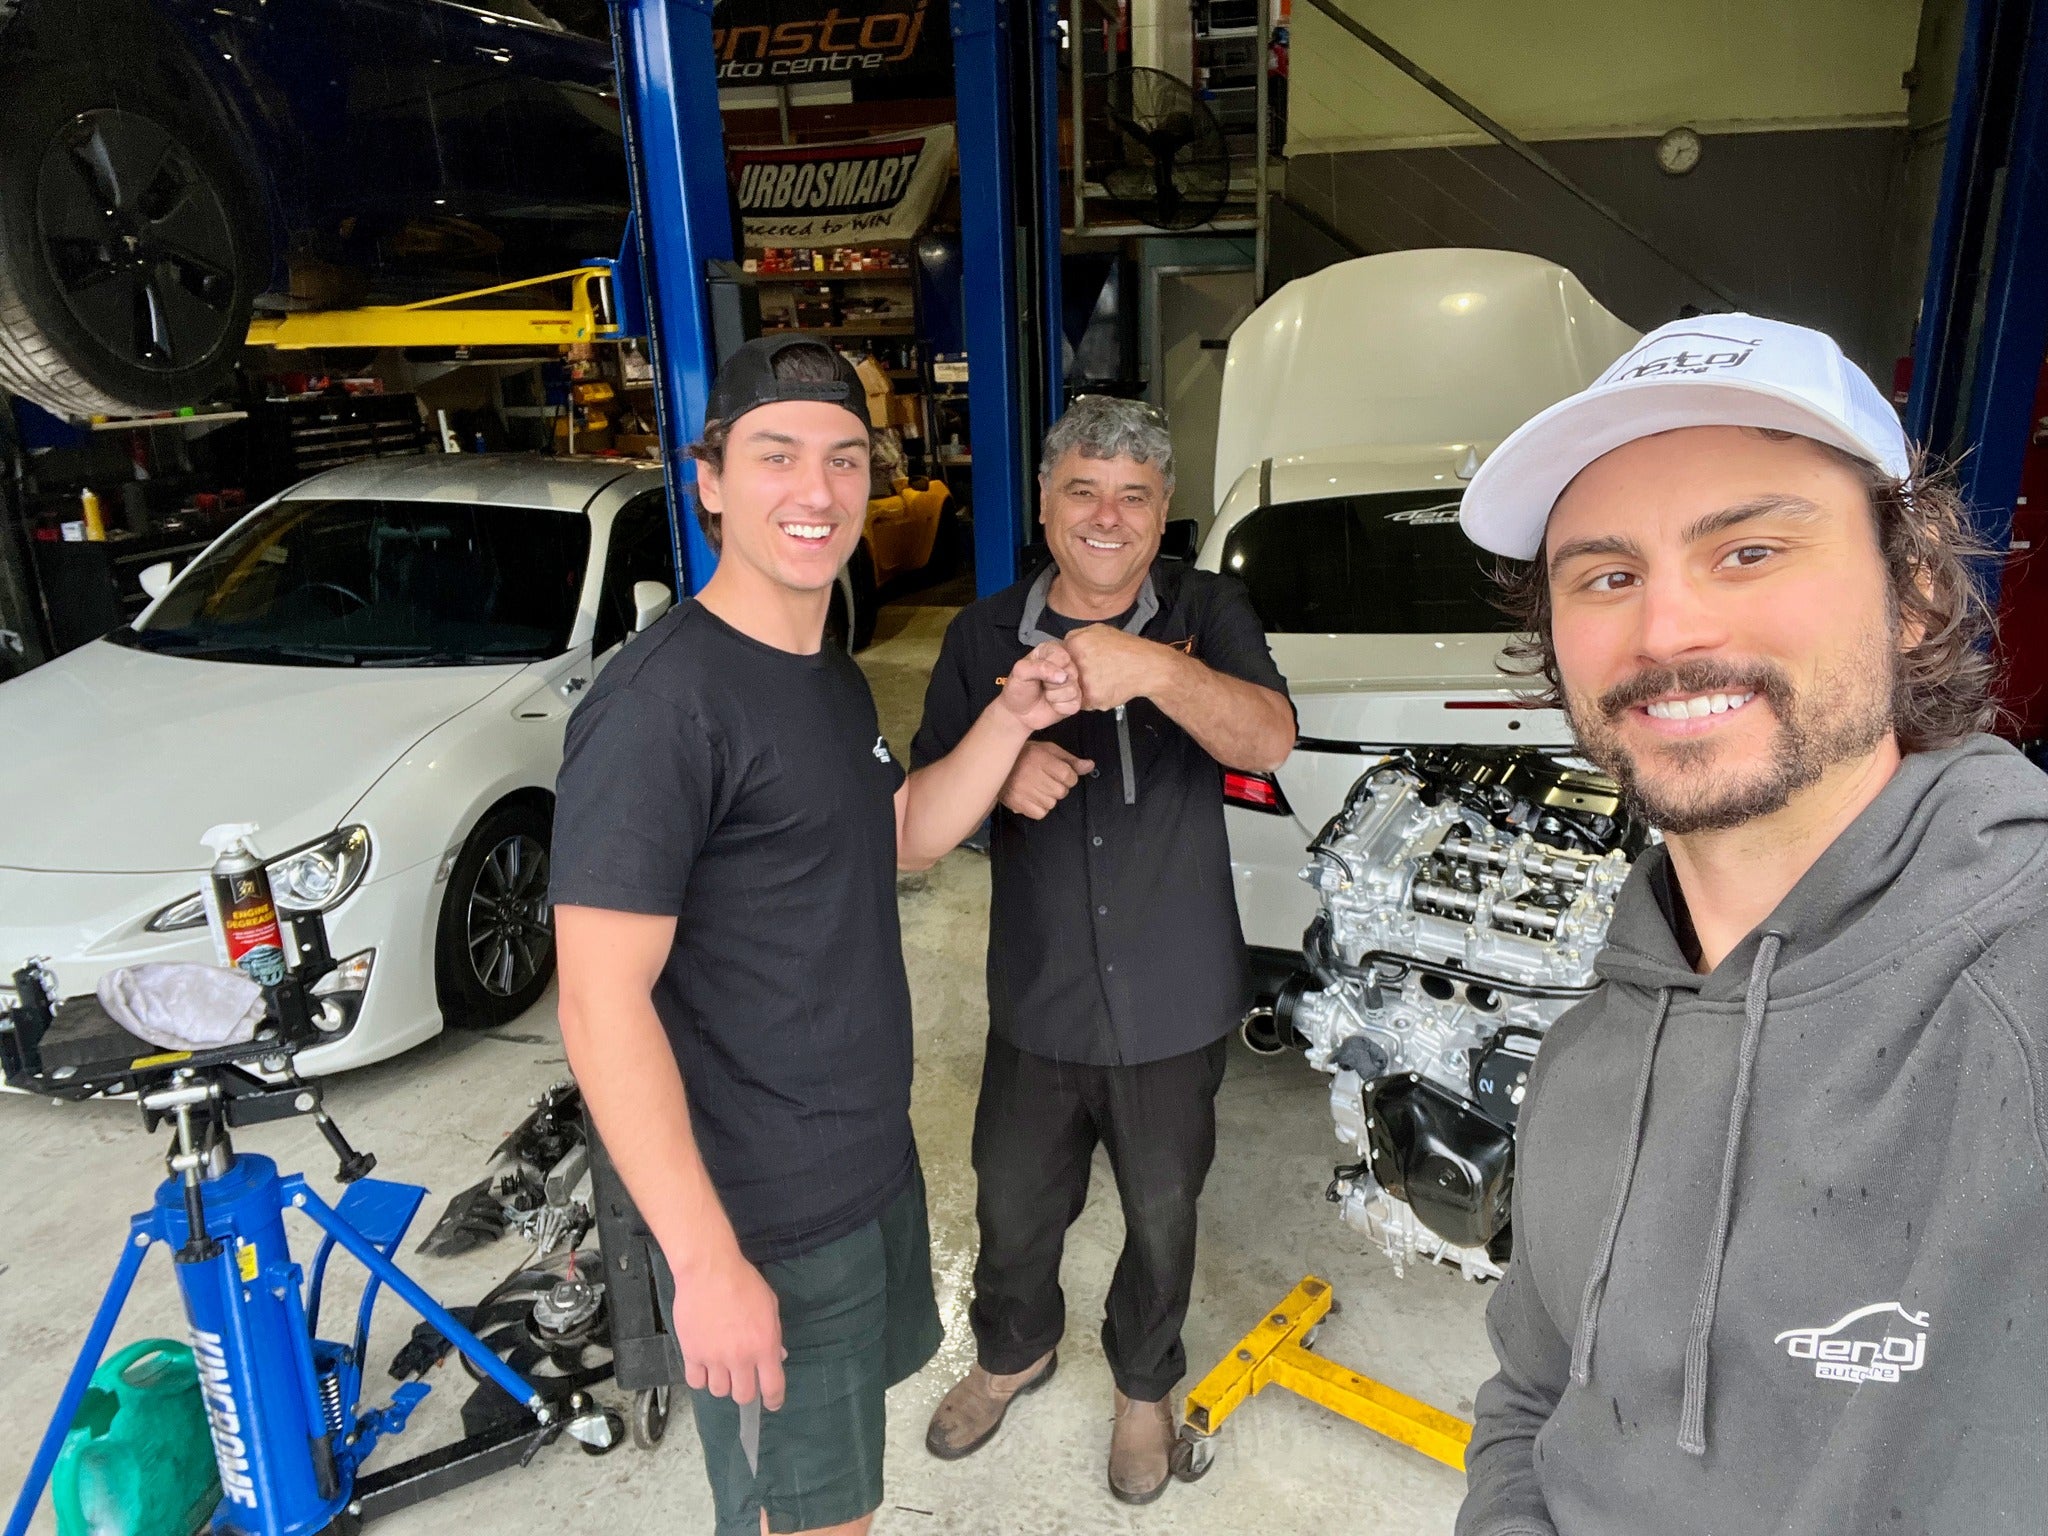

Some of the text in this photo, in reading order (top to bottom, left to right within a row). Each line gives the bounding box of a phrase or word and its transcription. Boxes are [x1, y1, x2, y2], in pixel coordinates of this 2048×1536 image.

[771, 52, 884, 75] centre
[738, 154, 918, 209] URBOSMART
[821, 219, 846, 235] to
[851, 212, 893, 231] WIN
[232, 903, 269, 920] ENGINE
[1479, 1078, 1494, 1095] 2
